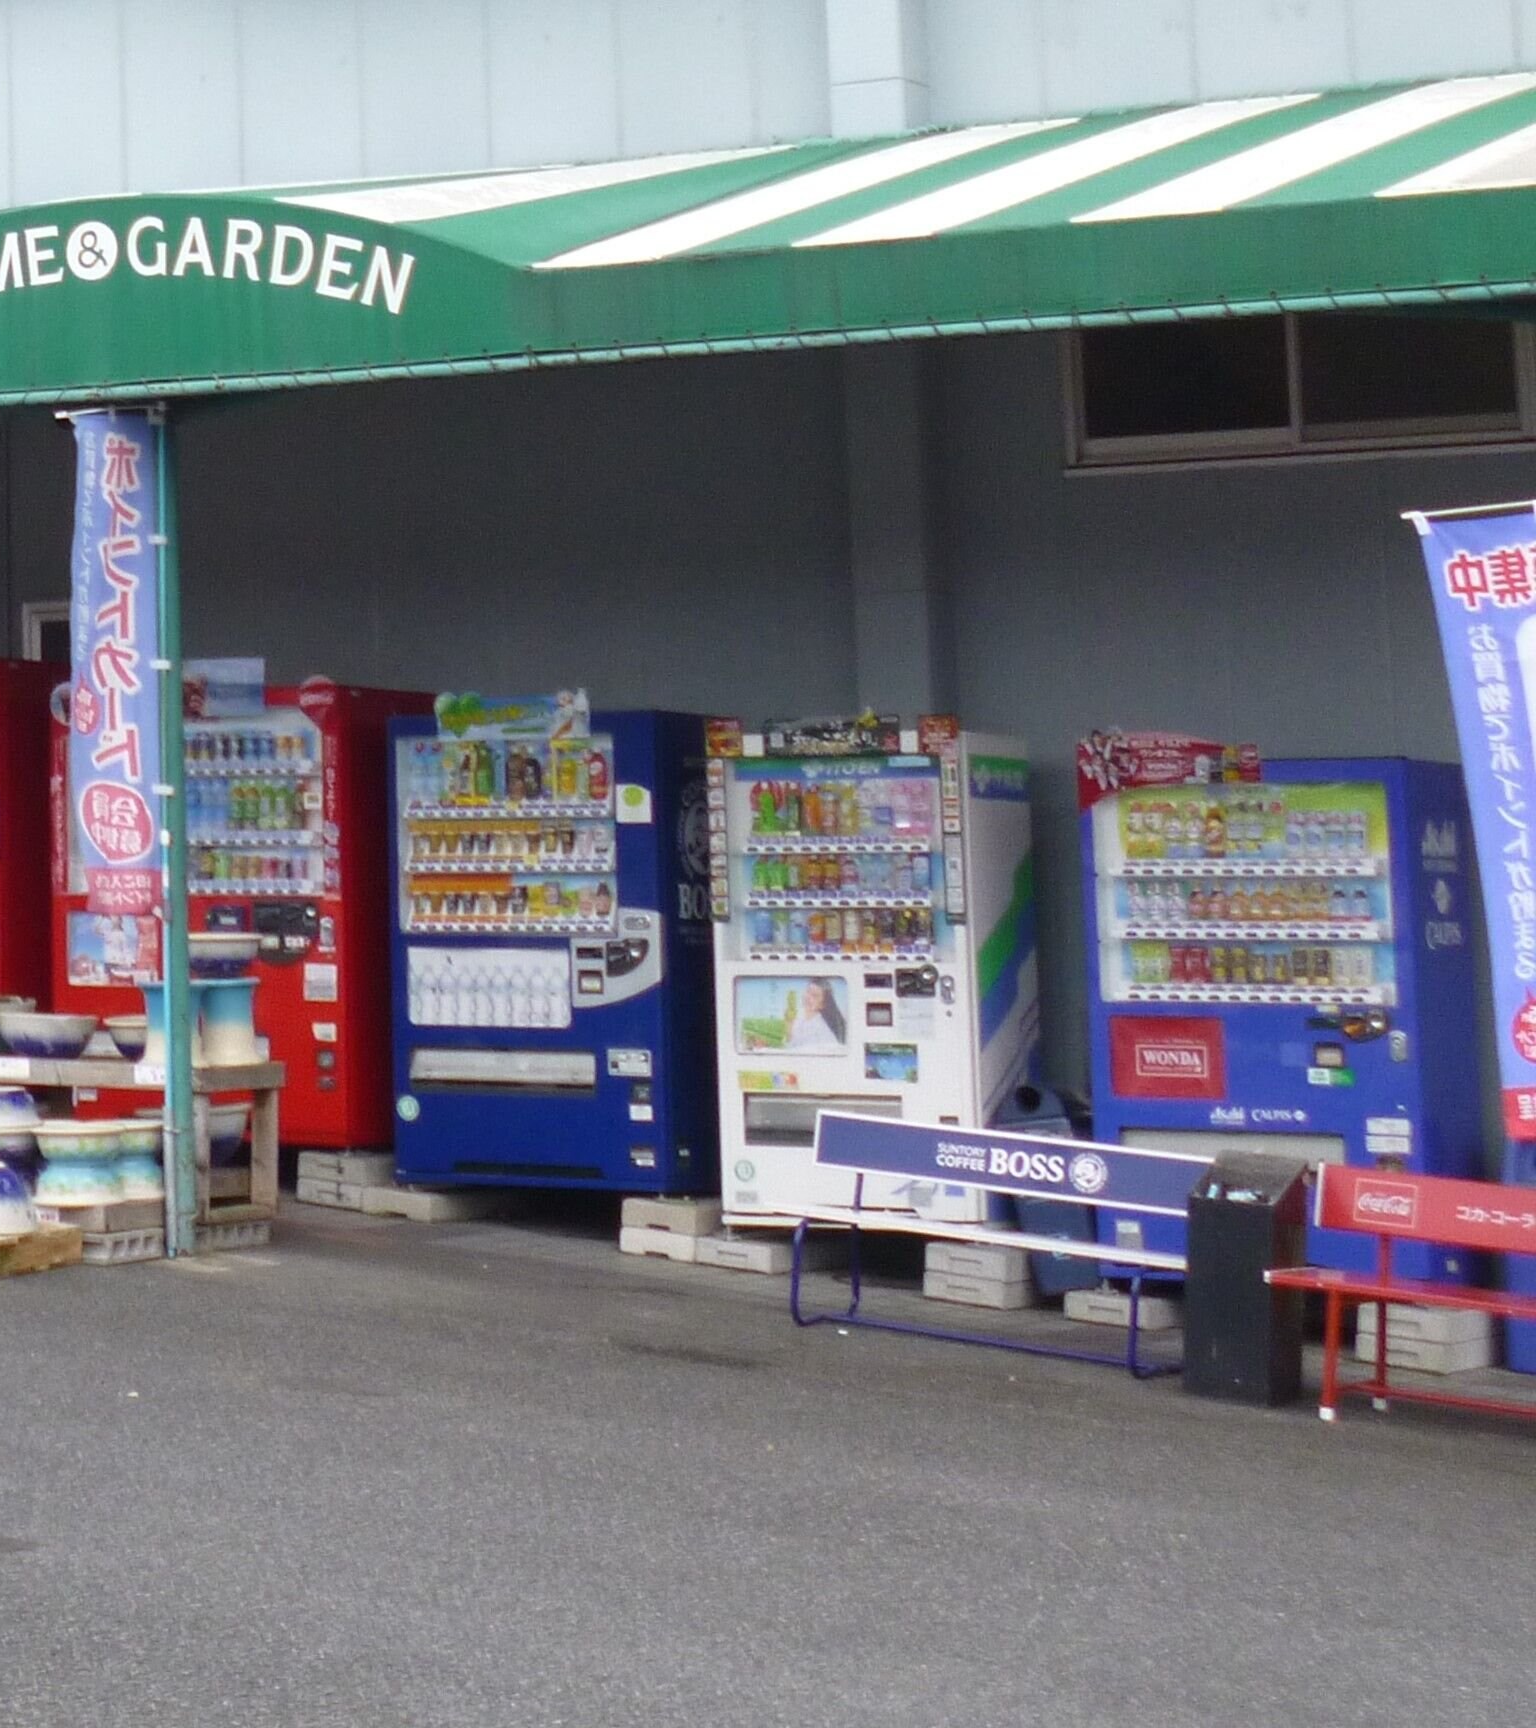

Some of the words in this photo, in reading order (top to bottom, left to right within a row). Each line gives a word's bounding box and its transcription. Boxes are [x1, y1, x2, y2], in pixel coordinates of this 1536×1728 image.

[1142, 1049, 1202, 1066] WONDA
[937, 1142, 986, 1157] SUNTORY
[936, 1155, 986, 1172] COFFEE
[988, 1147, 1065, 1183] BOSS
